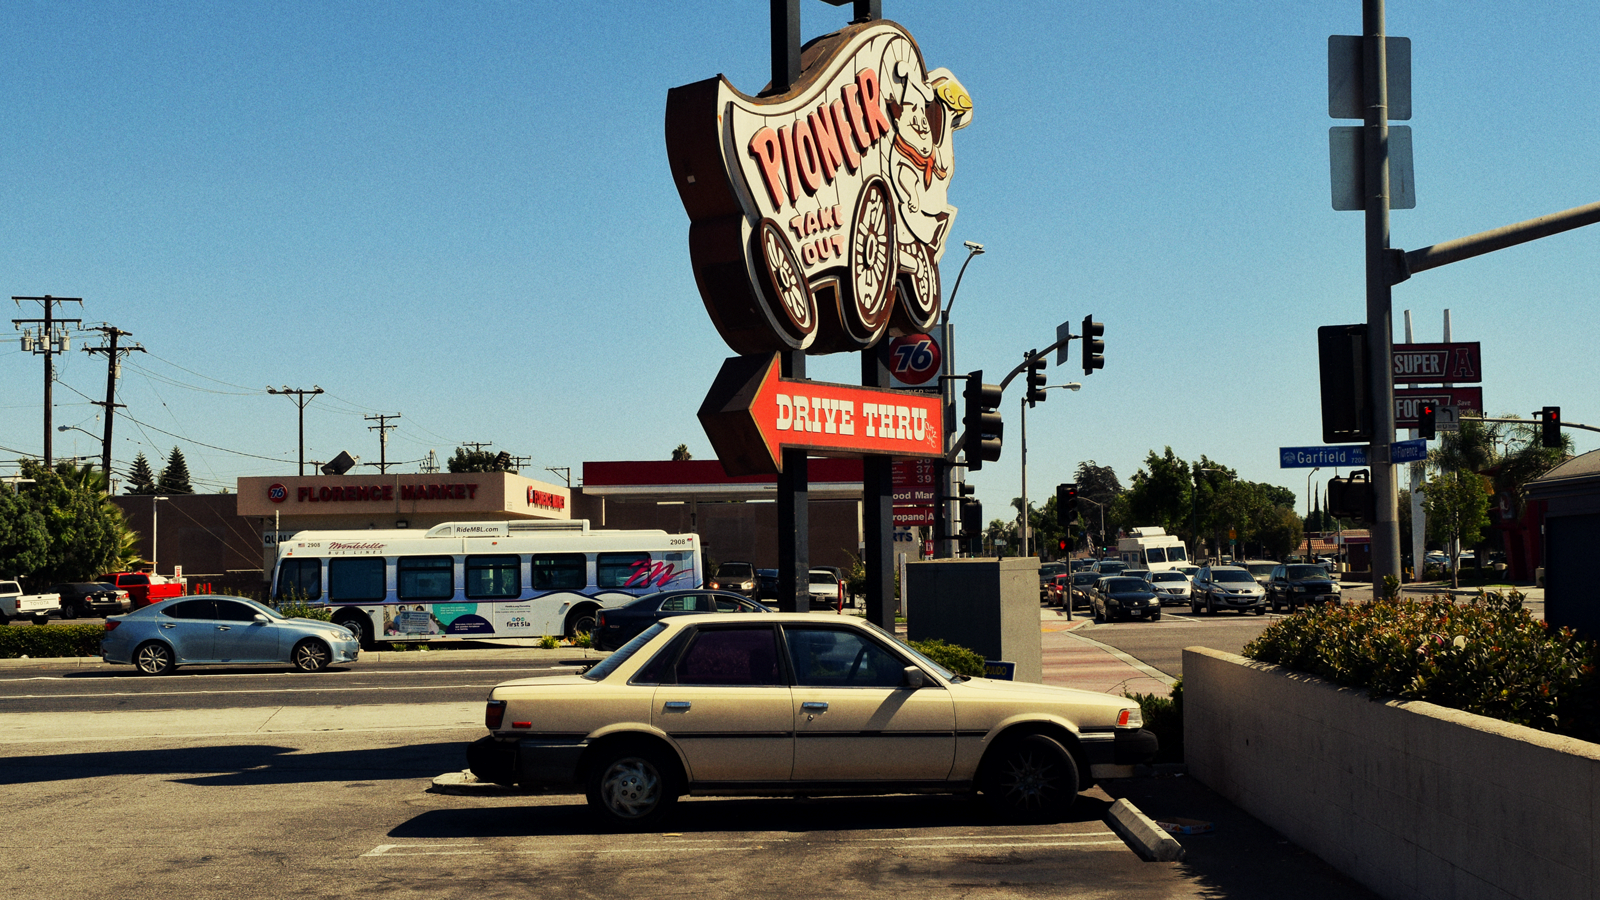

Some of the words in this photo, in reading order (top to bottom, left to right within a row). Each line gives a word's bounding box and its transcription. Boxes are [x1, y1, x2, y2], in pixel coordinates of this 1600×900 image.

[749, 67, 889, 212] PIONEER
[789, 205, 845, 237] TAKE
[801, 234, 845, 265] OUT
[893, 340, 934, 373] 76
[1394, 354, 1440, 374] SUPER
[1453, 348, 1474, 377] A
[1395, 398, 1440, 418] FOO
[776, 393, 855, 435] DRIVE
[862, 402, 928, 441] THRU
[1297, 451, 1346, 464] Garfield
[916, 466, 933, 474] 37
[917, 475, 934, 484] 39
[270, 487, 284, 499] 76
[297, 485, 394, 502] FLORENCE
[401, 483, 479, 500] MARKET
[892, 491, 911, 500] ood
[914, 491, 935, 499] Mar
[892, 513, 925, 522] ropane
[328, 541, 388, 549] Montebello
[892, 533, 913, 541] RTS
